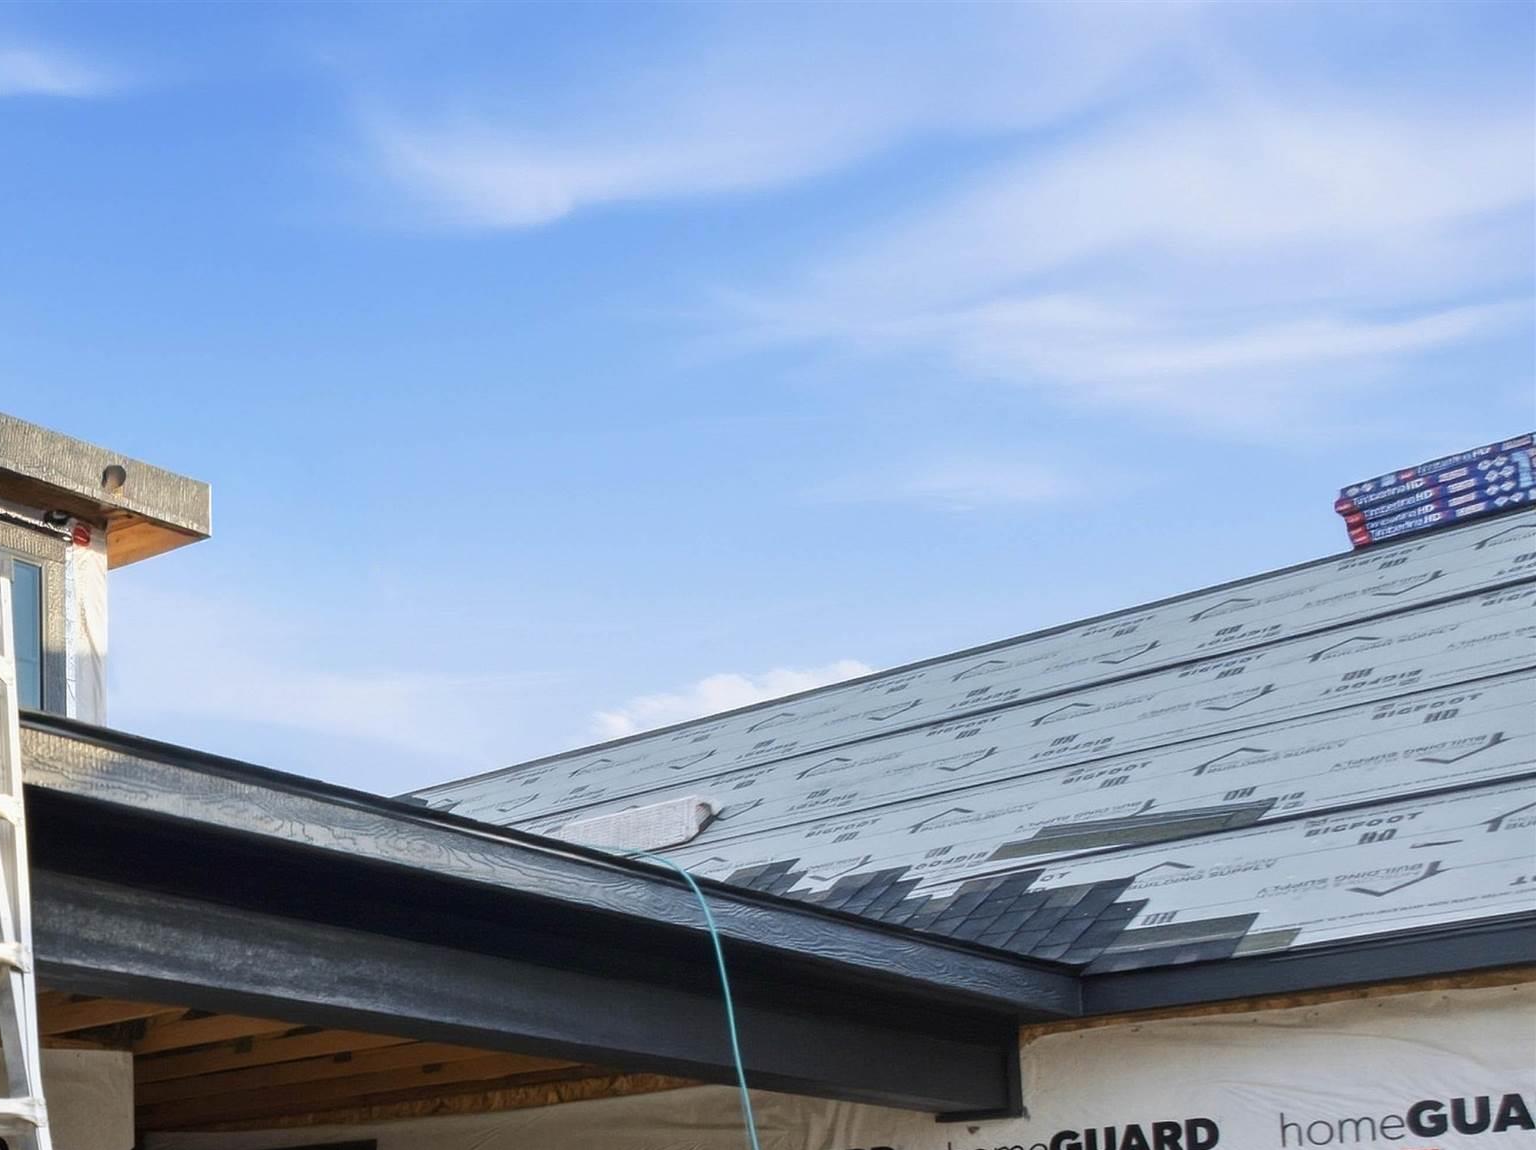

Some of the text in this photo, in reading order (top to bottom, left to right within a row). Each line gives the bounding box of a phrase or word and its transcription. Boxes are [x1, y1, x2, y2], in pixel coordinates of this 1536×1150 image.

[1371, 693, 1484, 721] BIGFOOT
[1422, 708, 1460, 725] HD
[1304, 812, 1425, 838] BIGFOOT
[1357, 828, 1399, 846] HD
[1280, 1093, 1536, 1148] homeGUA
